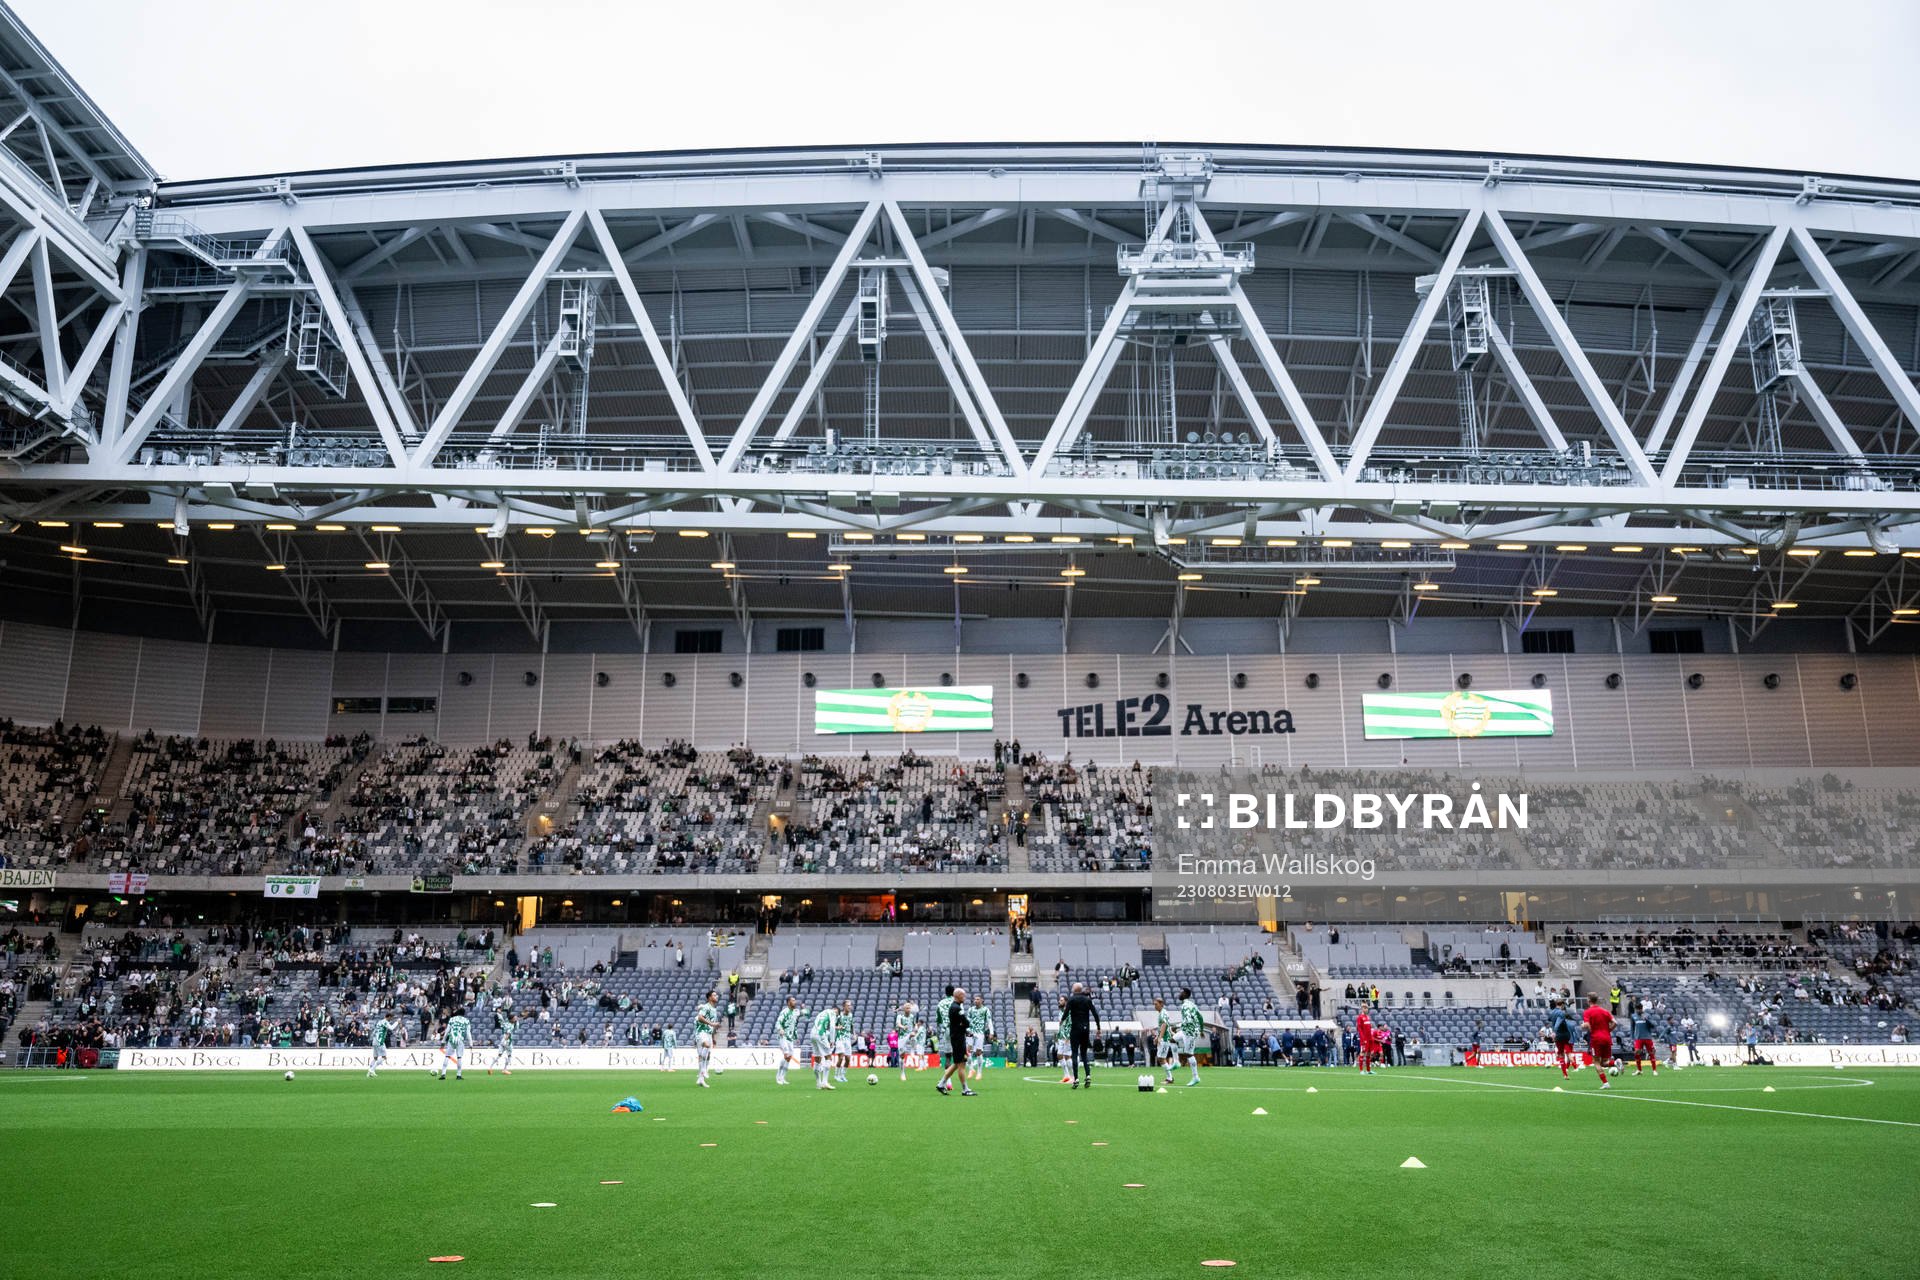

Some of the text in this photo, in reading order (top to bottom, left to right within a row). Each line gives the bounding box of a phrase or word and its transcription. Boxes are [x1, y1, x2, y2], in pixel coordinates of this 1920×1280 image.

[1057, 693, 1296, 738] TELE2 Arena
[3, 870, 54, 886] BAJEN
[192, 1052, 240, 1067] BYGG
[404, 1052, 434, 1066] AB
[744, 1052, 775, 1066] AB
